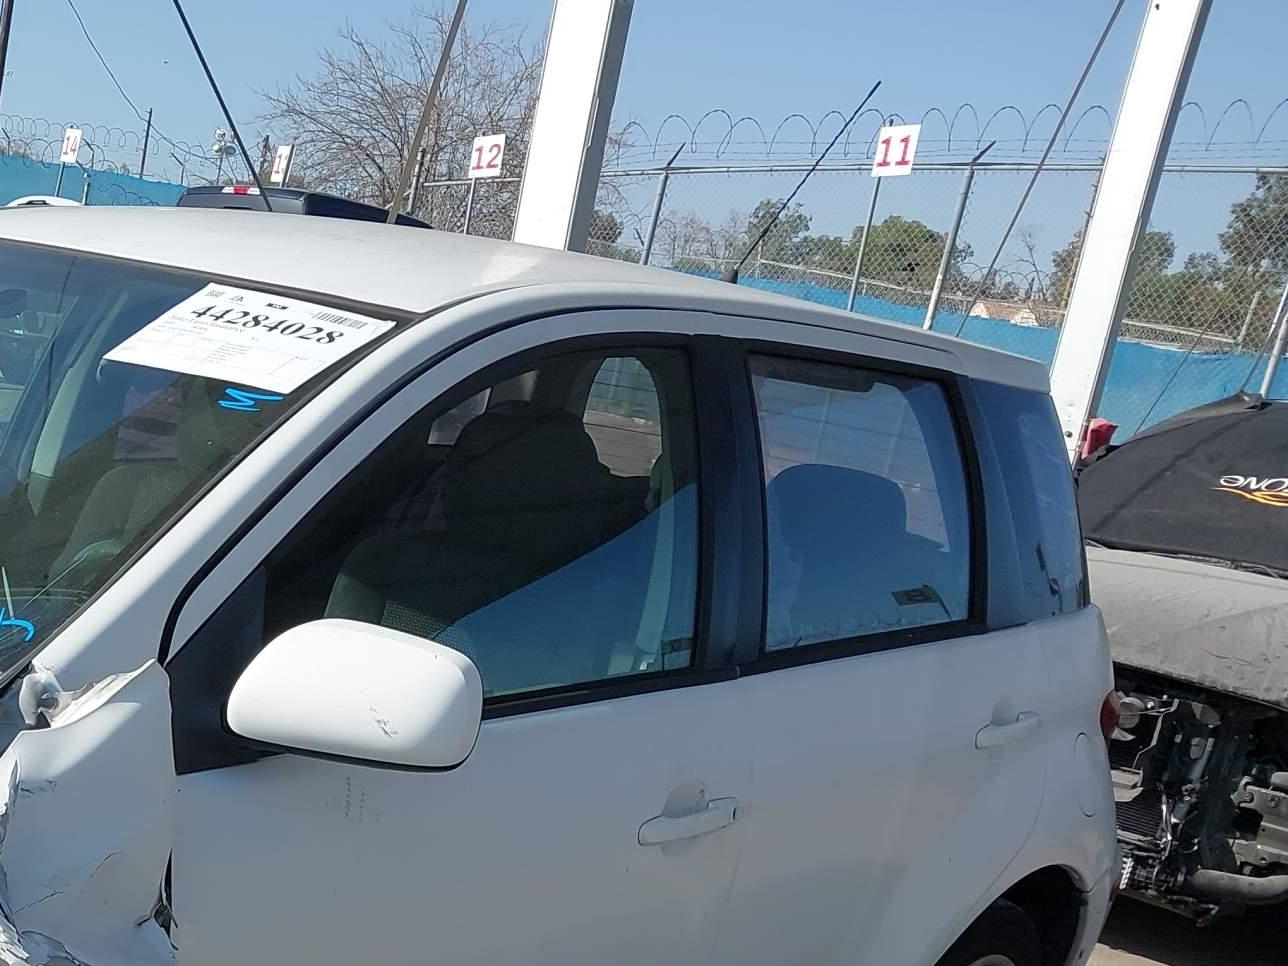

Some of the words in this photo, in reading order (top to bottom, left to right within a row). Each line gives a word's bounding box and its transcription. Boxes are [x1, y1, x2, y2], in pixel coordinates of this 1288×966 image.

[63, 135, 78, 156] 14
[472, 143, 501, 170] 12
[876, 135, 911, 167] 11
[190, 304, 344, 345] 44284028
